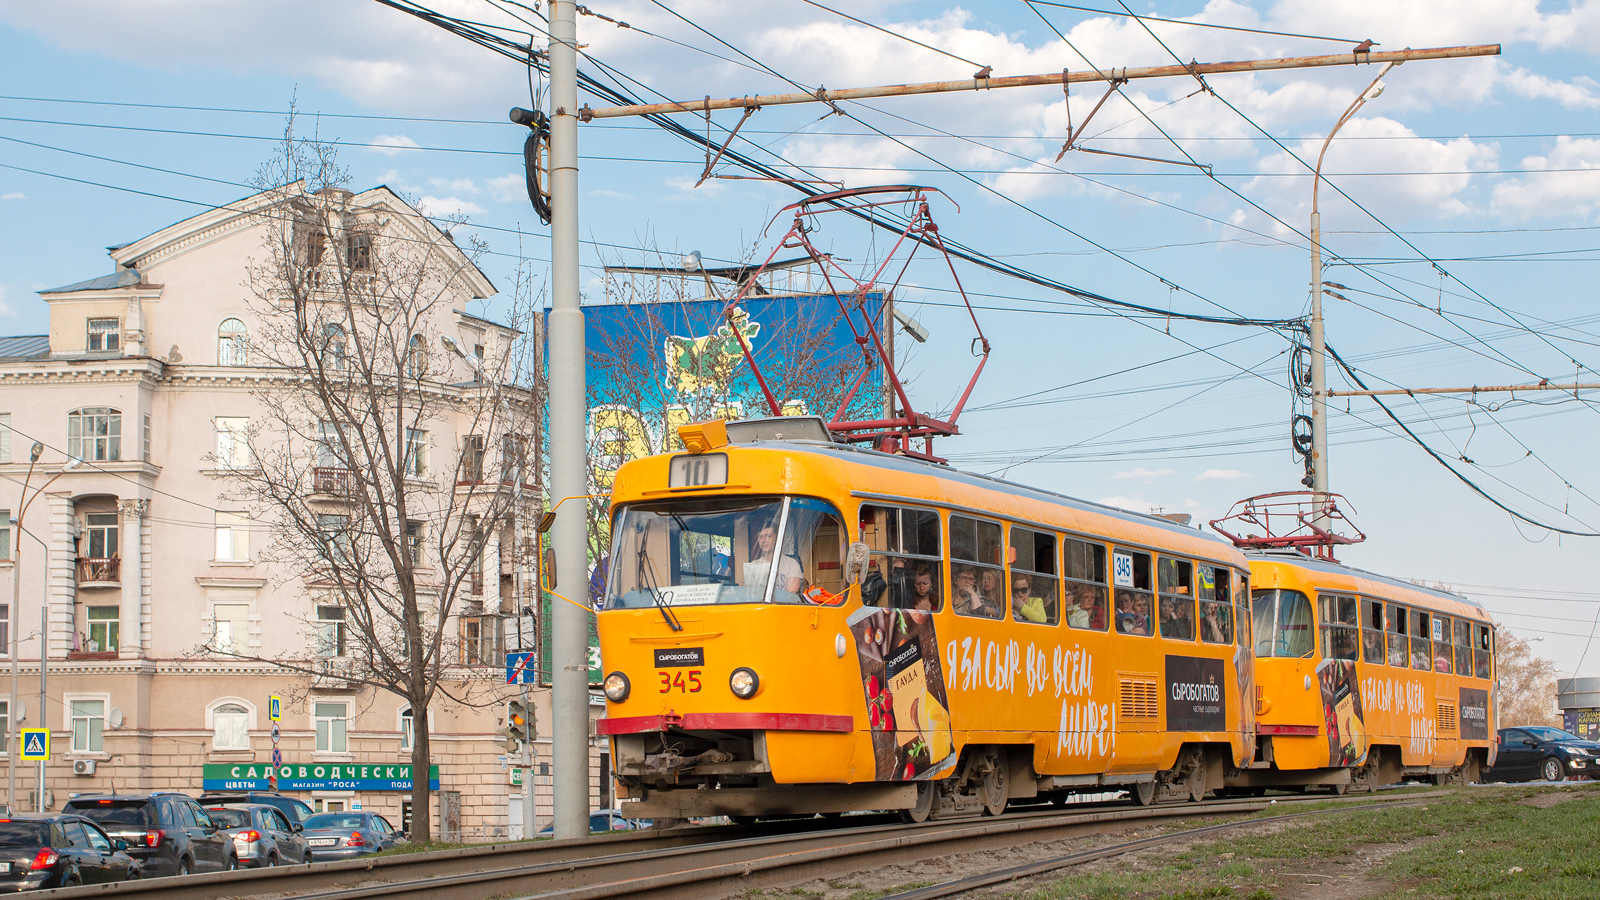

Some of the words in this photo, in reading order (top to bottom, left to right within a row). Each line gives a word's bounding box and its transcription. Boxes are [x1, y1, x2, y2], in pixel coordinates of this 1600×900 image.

[682, 460, 709, 487] 10
[1116, 556, 1131, 577] 345
[658, 653, 699, 661] СЫРОБОГАТОВ
[947, 639, 957, 690] Я
[961, 636, 982, 692] ЗА
[985, 638, 1022, 695] СЫР
[1026, 641, 1050, 698] ВО
[1053, 643, 1094, 699] ВСЁМ
[658, 670, 702, 693] 345
[896, 669, 918, 690] ГАУДА
[1171, 682, 1220, 702] СЫРОБОГАТОВ
[1361, 679, 1367, 712] Я
[1367, 676, 1377, 712] ЗА
[1377, 677, 1393, 715] СЫР
[1394, 679, 1405, 715] ВО
[1406, 680, 1425, 716] ВСЁМ
[1056, 698, 1116, 762] МИРЕ!
[1410, 715, 1437, 757] МИРЕ!
[231, 766, 409, 779] САДОВОДЧЕСКИ
[225, 781, 256, 789] ЦВЕТЫ
[391, 781, 414, 789] ПОДА
